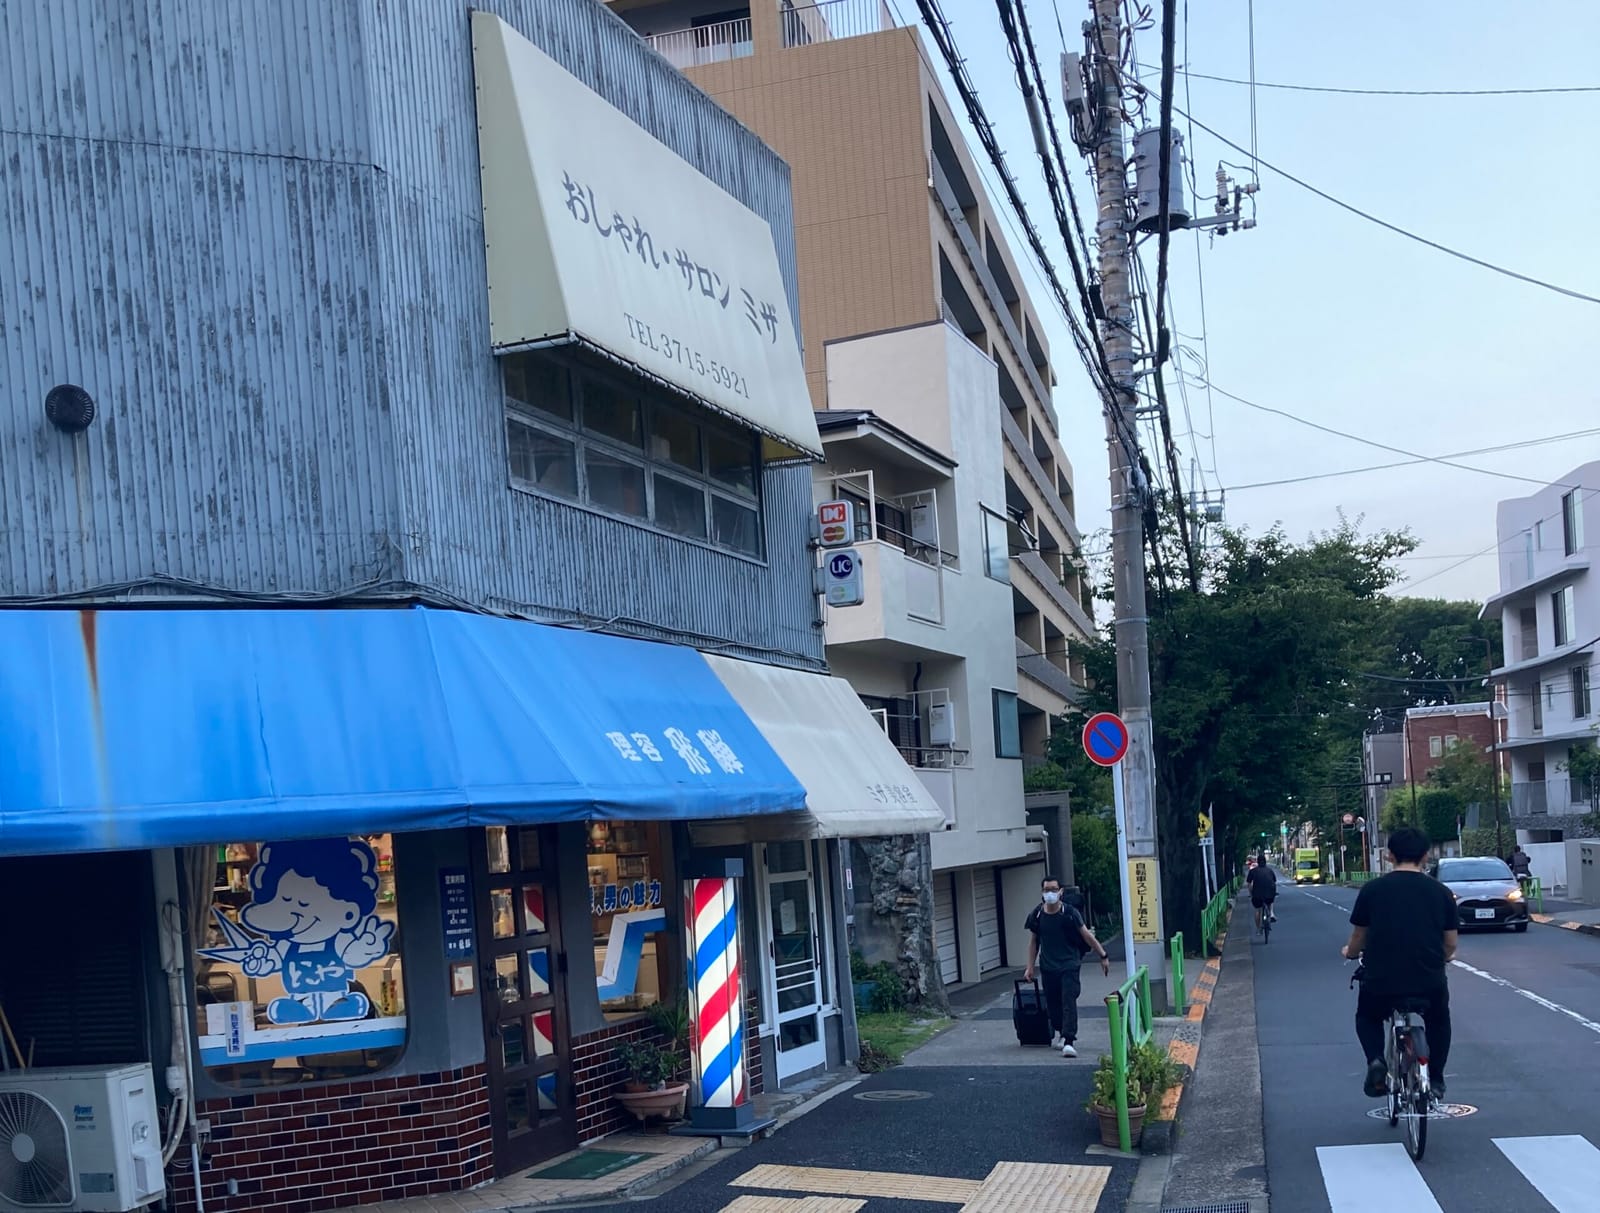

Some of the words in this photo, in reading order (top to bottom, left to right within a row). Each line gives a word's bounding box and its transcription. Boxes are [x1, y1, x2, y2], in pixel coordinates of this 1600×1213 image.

[562, 170, 730, 309] おしゃれ・サロン
[740, 287, 778, 344] ミザ
[623, 312, 659, 352] TEL
[660, 333, 750, 399] 3715-5921
[822, 505, 844, 523] DC
[831, 561, 852, 574] UC
[605, 732, 664, 762] 理容
[1135, 862, 1149, 928] 自転車スピード落とせ
[288, 960, 345, 988] とこや
